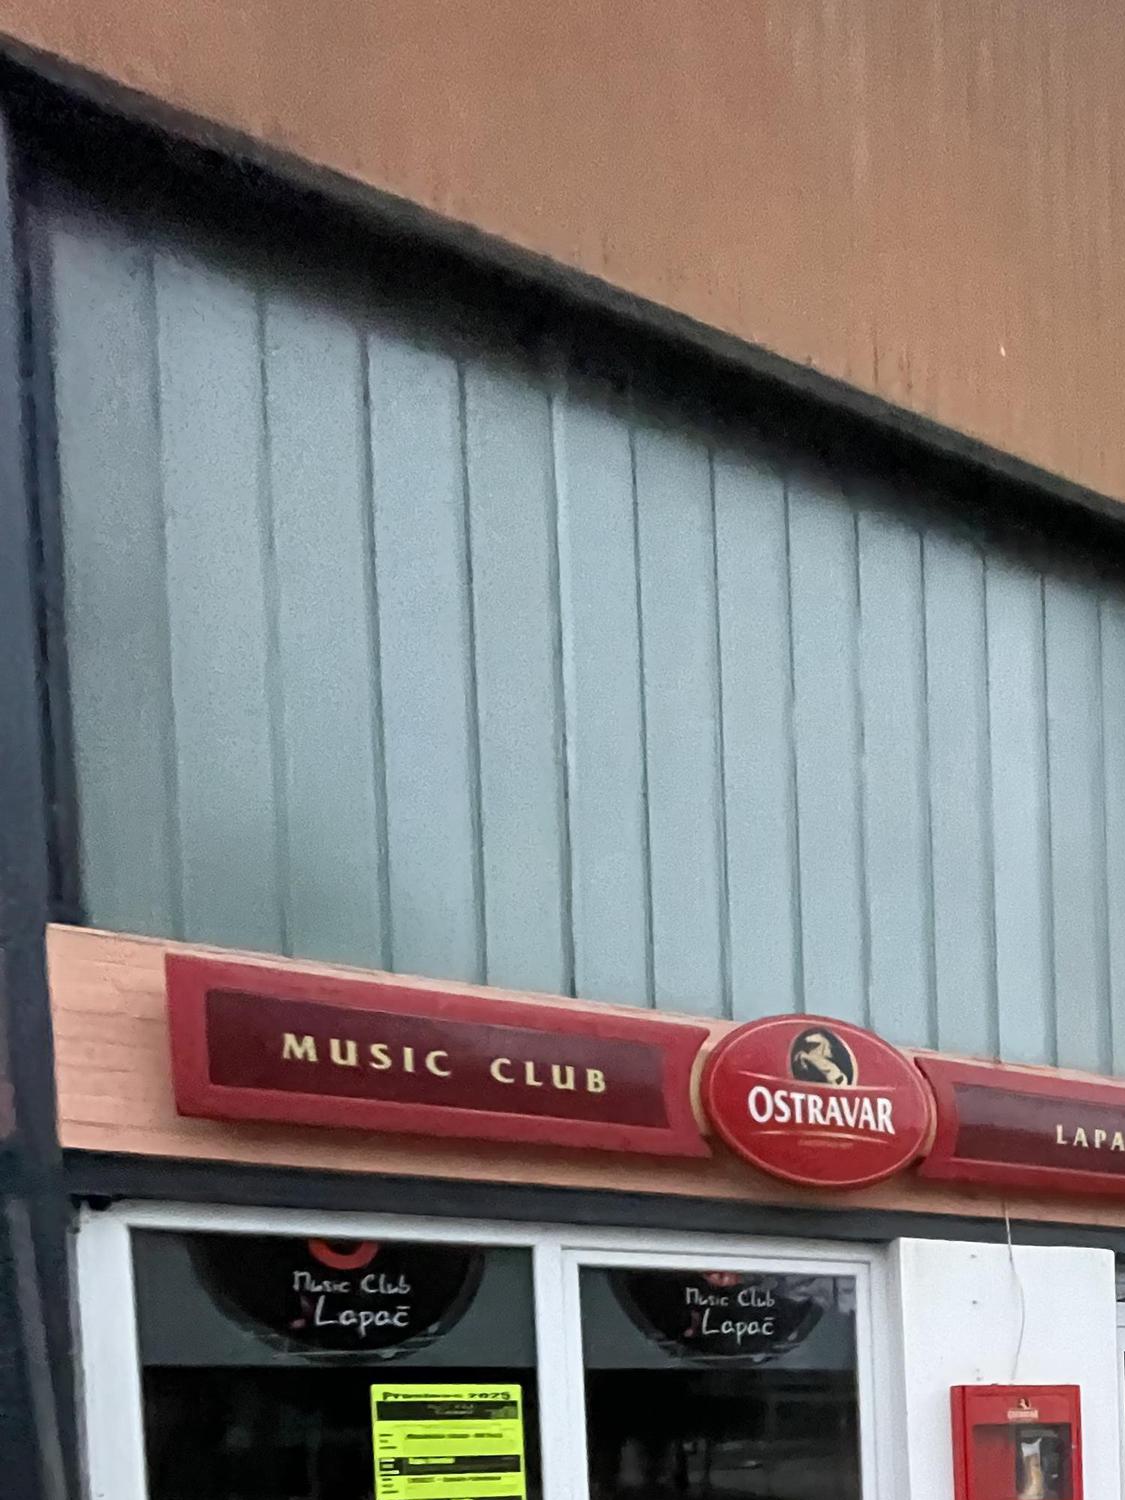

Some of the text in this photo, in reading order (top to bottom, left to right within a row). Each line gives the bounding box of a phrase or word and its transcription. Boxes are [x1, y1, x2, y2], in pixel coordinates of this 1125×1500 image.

[282, 1033, 609, 1094] MUSIC CLUB
[747, 1085, 896, 1135] OSTRAVAR
[293, 1270, 411, 1294] Music Club
[685, 1287, 775, 1307] Music Club
[315, 1296, 411, 1339] Lapač
[701, 1308, 775, 1345] Lapač
